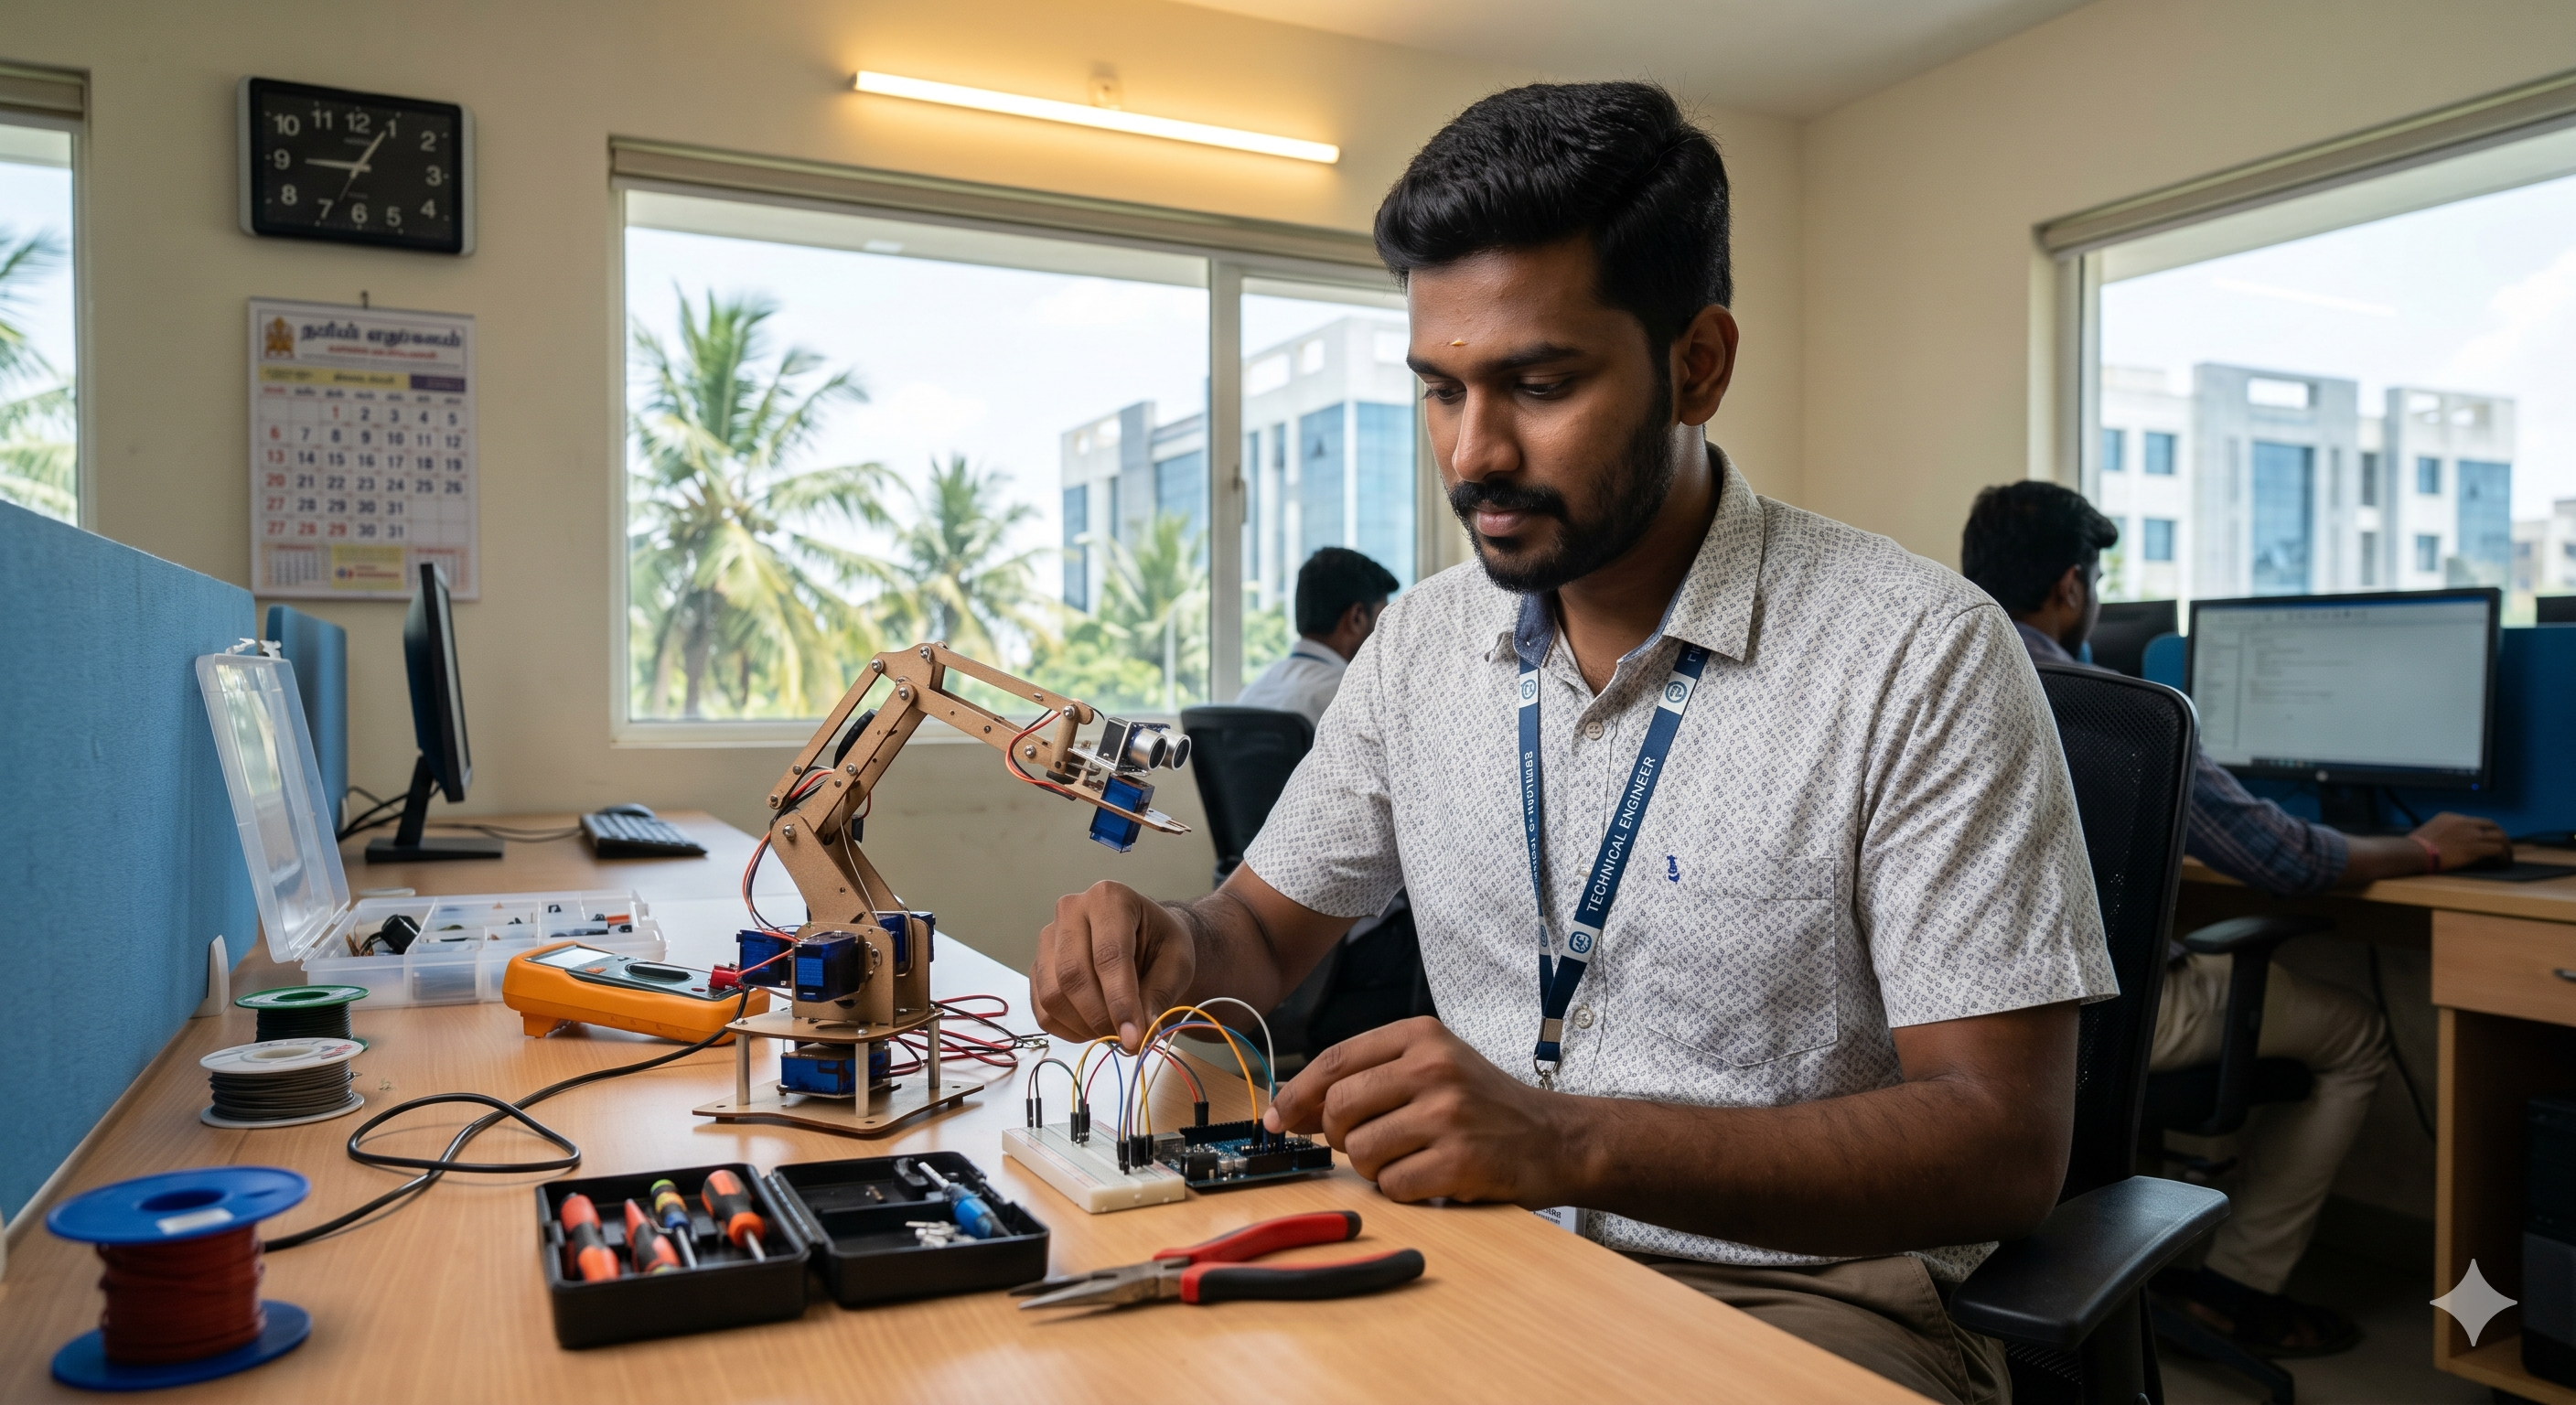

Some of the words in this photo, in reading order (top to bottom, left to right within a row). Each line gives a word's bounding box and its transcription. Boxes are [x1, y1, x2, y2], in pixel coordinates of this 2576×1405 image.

[274, 113, 300, 136] 10
[311, 109, 333, 131] 11
[346, 111, 370, 134] 12
[386, 119, 397, 138] 1
[420, 131, 436, 152] 2
[274, 149, 291, 170] 9
[425, 165, 443, 187] 3
[281, 185, 298, 206] 8
[317, 198, 334, 220] 7
[351, 203, 368, 224] 6
[386, 206, 402, 227] 5
[420, 198, 436, 220] 4
[360, 407, 370, 422] 2
[390, 409, 400, 424] 3
[419, 411, 429, 424] 4
[447, 413, 457, 426] 5
[302, 427, 310, 441] 7
[330, 429, 341, 444] 8
[360, 430, 371, 445] 9
[387, 432, 404, 445] 10
[417, 434, 432, 446] 11
[445, 434, 462, 449] 12
[267, 449, 284, 464] 13
[298, 451, 315, 465] 14
[328, 453, 345, 467] 15
[358, 454, 375, 467] 16
[388, 456, 403, 468] 17
[417, 456, 434, 470] 18
[445, 458, 462, 472] 19
[266, 473, 285, 487] 20
[297, 475, 314, 488] 21
[327, 476, 346, 489] 22
[358, 477, 375, 491] 23
[387, 478, 404, 492] 24
[416, 479, 434, 493] 25
[267, 497, 284, 511] 27
[327, 499, 347, 513] 29
[358, 500, 376, 514] 30
[387, 502, 403, 515] 31
[388, 525, 403, 538] 31
[1586, 834, 1627, 912] TECHNICAL
[1618, 756, 1656, 830] ENGINEER
